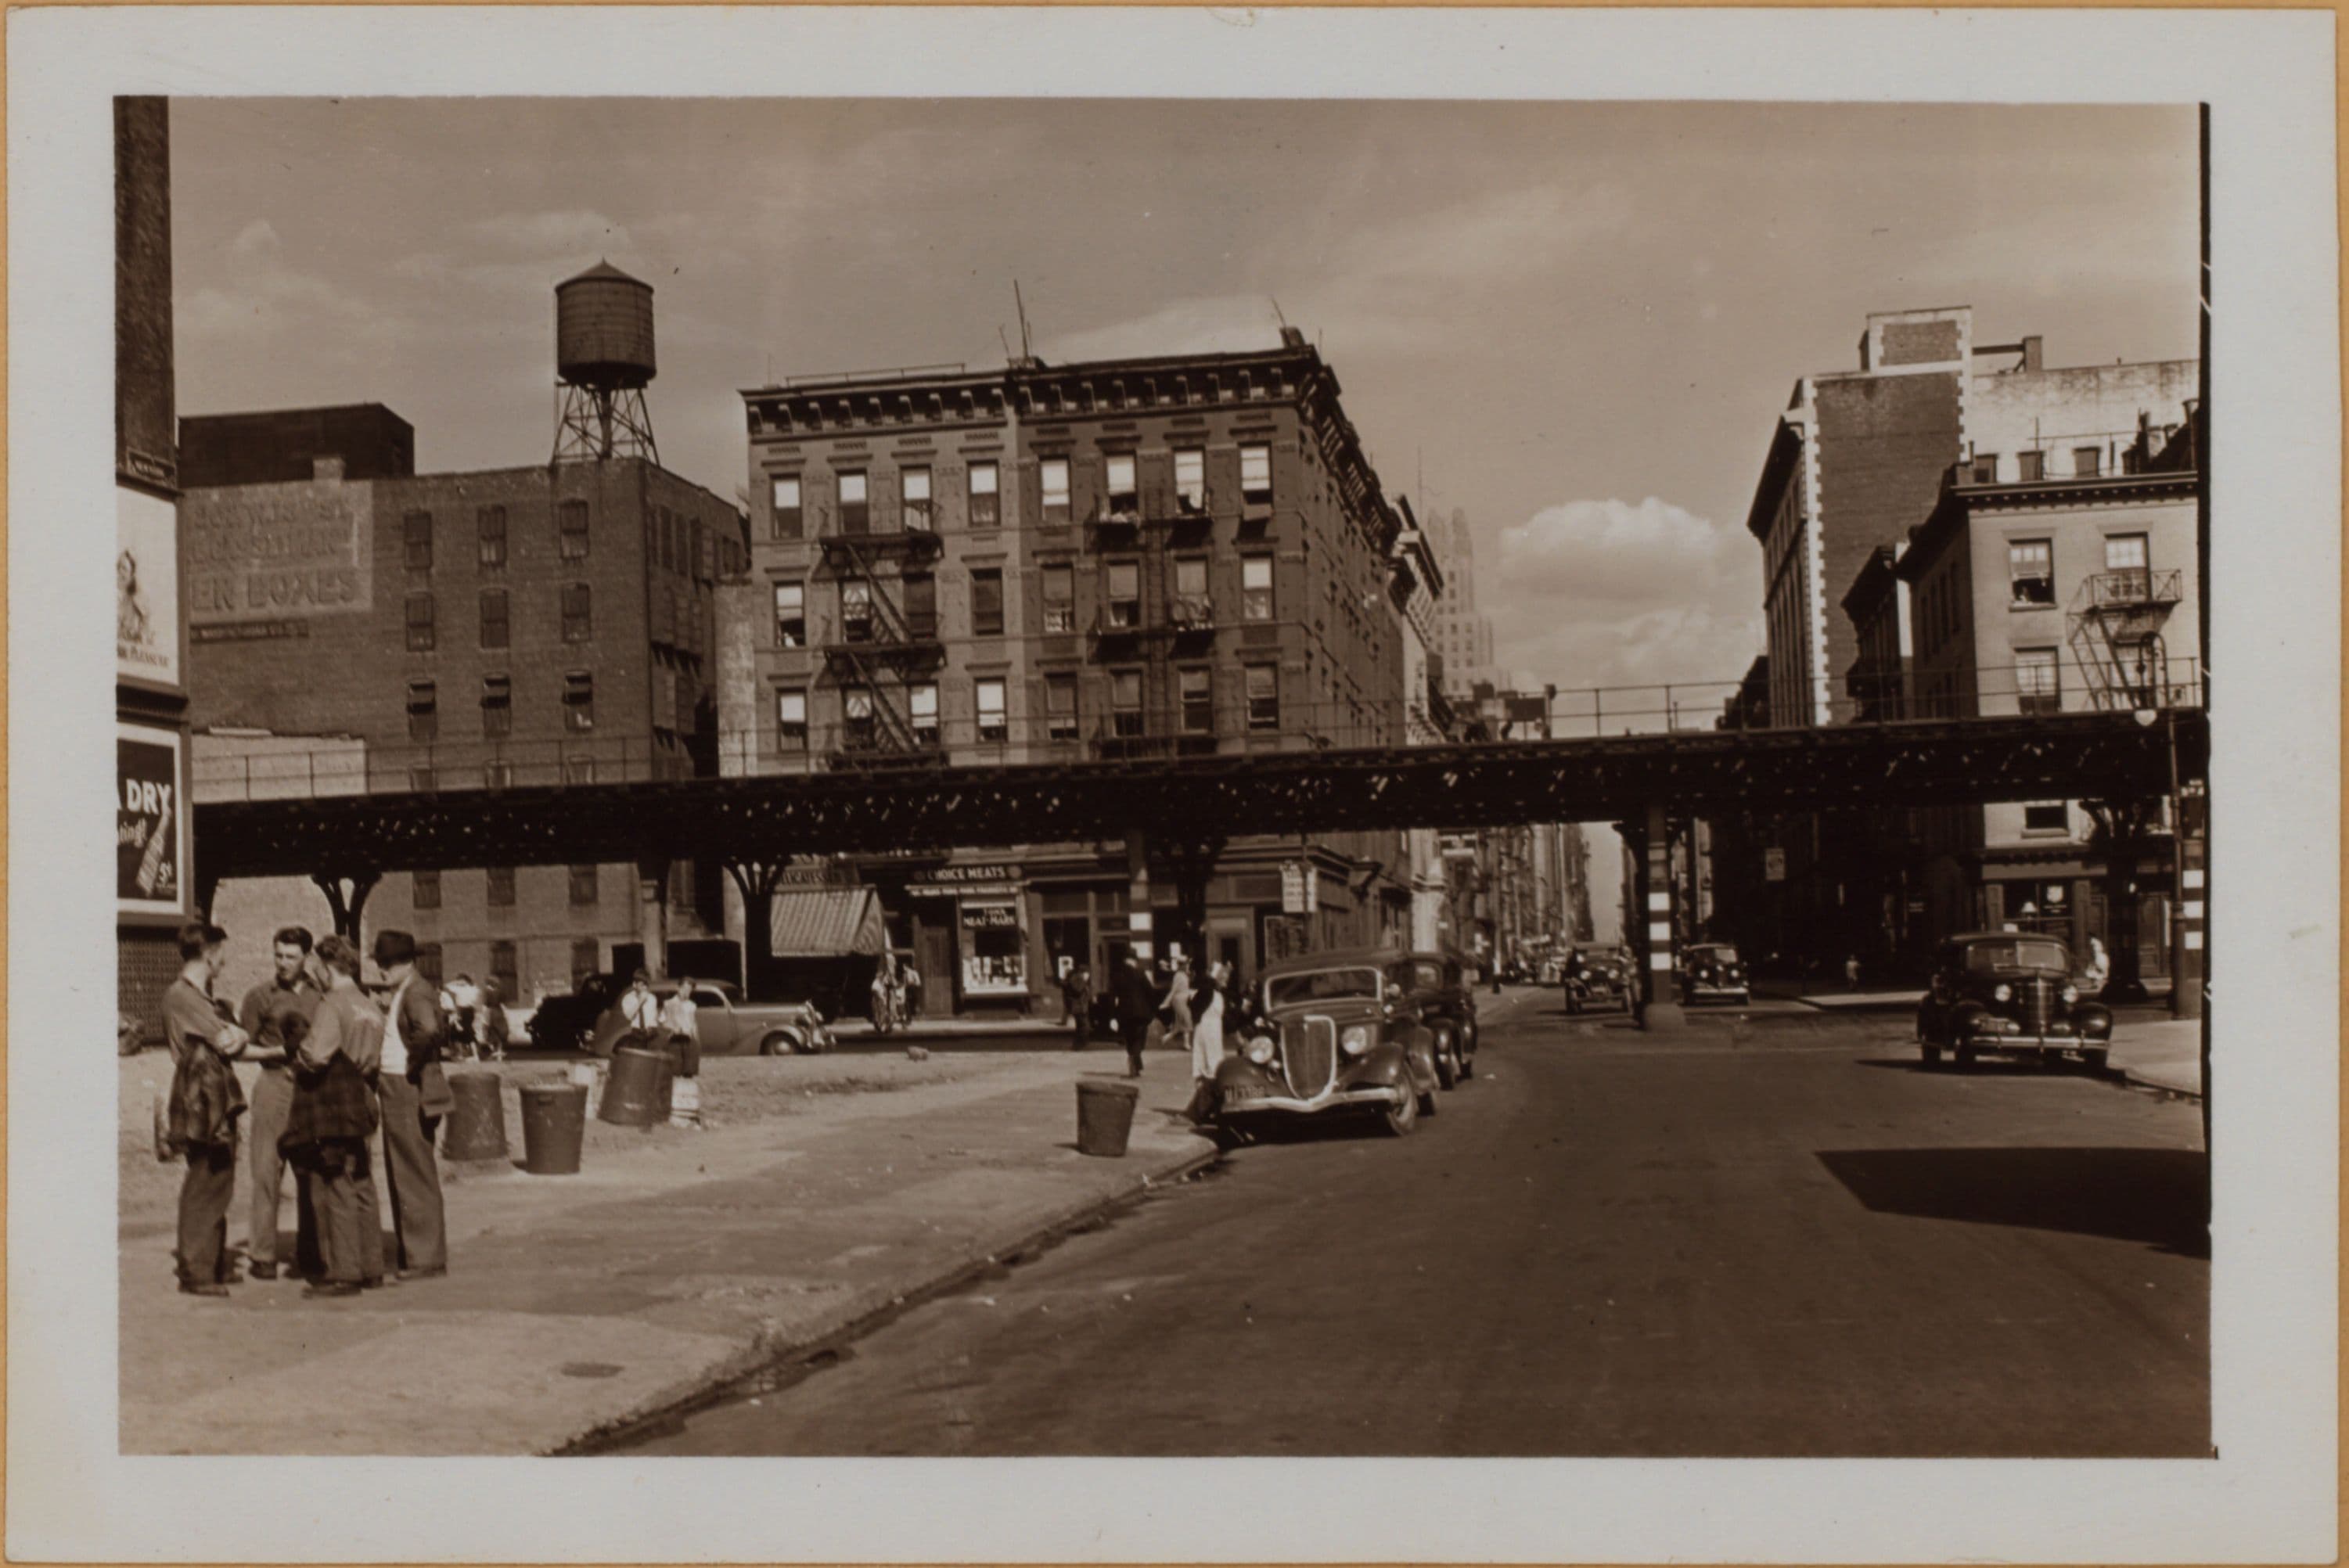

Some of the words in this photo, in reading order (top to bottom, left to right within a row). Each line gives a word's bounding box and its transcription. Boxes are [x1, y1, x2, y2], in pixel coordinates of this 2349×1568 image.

[126, 779, 171, 815] DRY
[926, 868, 966, 882] CHOICE
[966, 865, 1006, 879] MEATS
